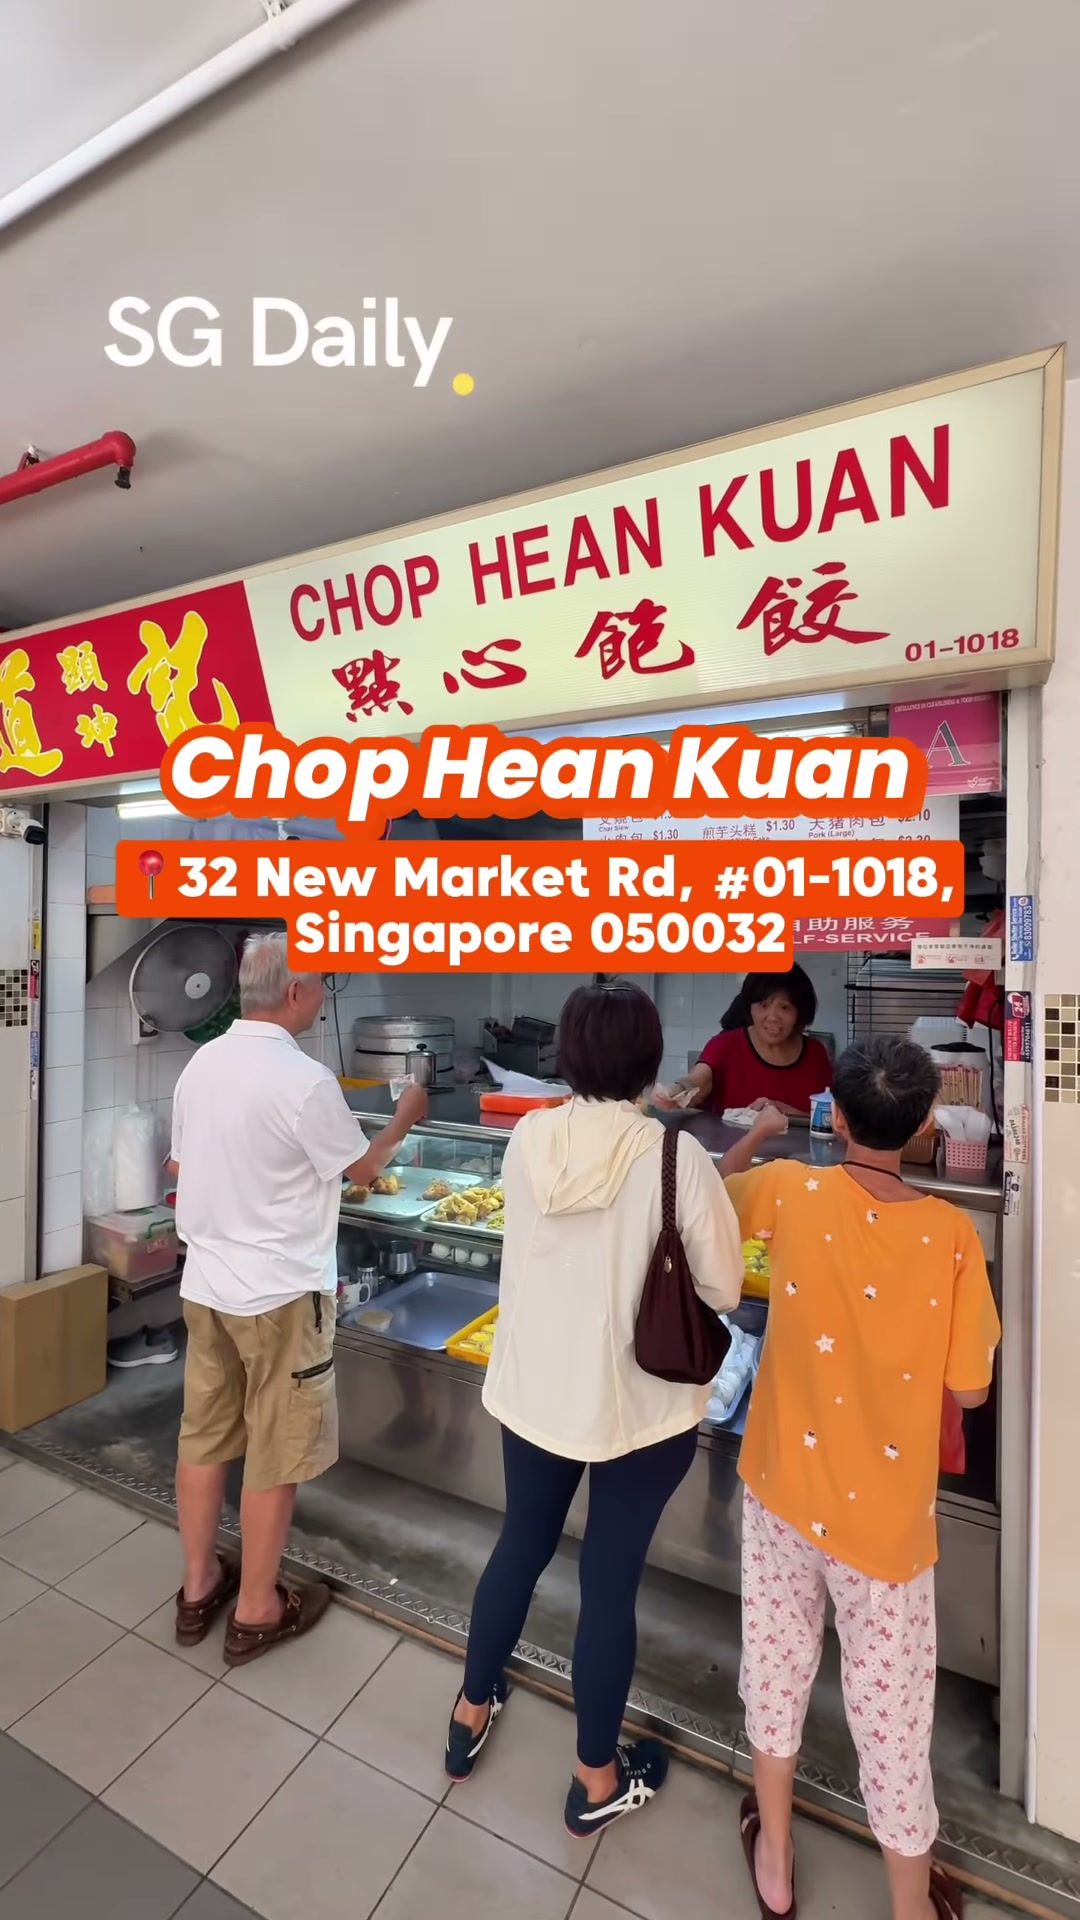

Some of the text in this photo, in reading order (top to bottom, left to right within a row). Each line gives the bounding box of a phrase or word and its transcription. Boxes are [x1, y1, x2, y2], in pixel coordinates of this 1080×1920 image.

[292, 424, 949, 642] CHOP HEAN KUAN
[905, 628, 1019, 662] 01-1018
[925, 720, 971, 769] A
[653, 829, 679, 840] $1.30
[766, 819, 795, 832] $1.30
[808, 831, 826, 839] Pork
[827, 829, 855, 838] (Large)
